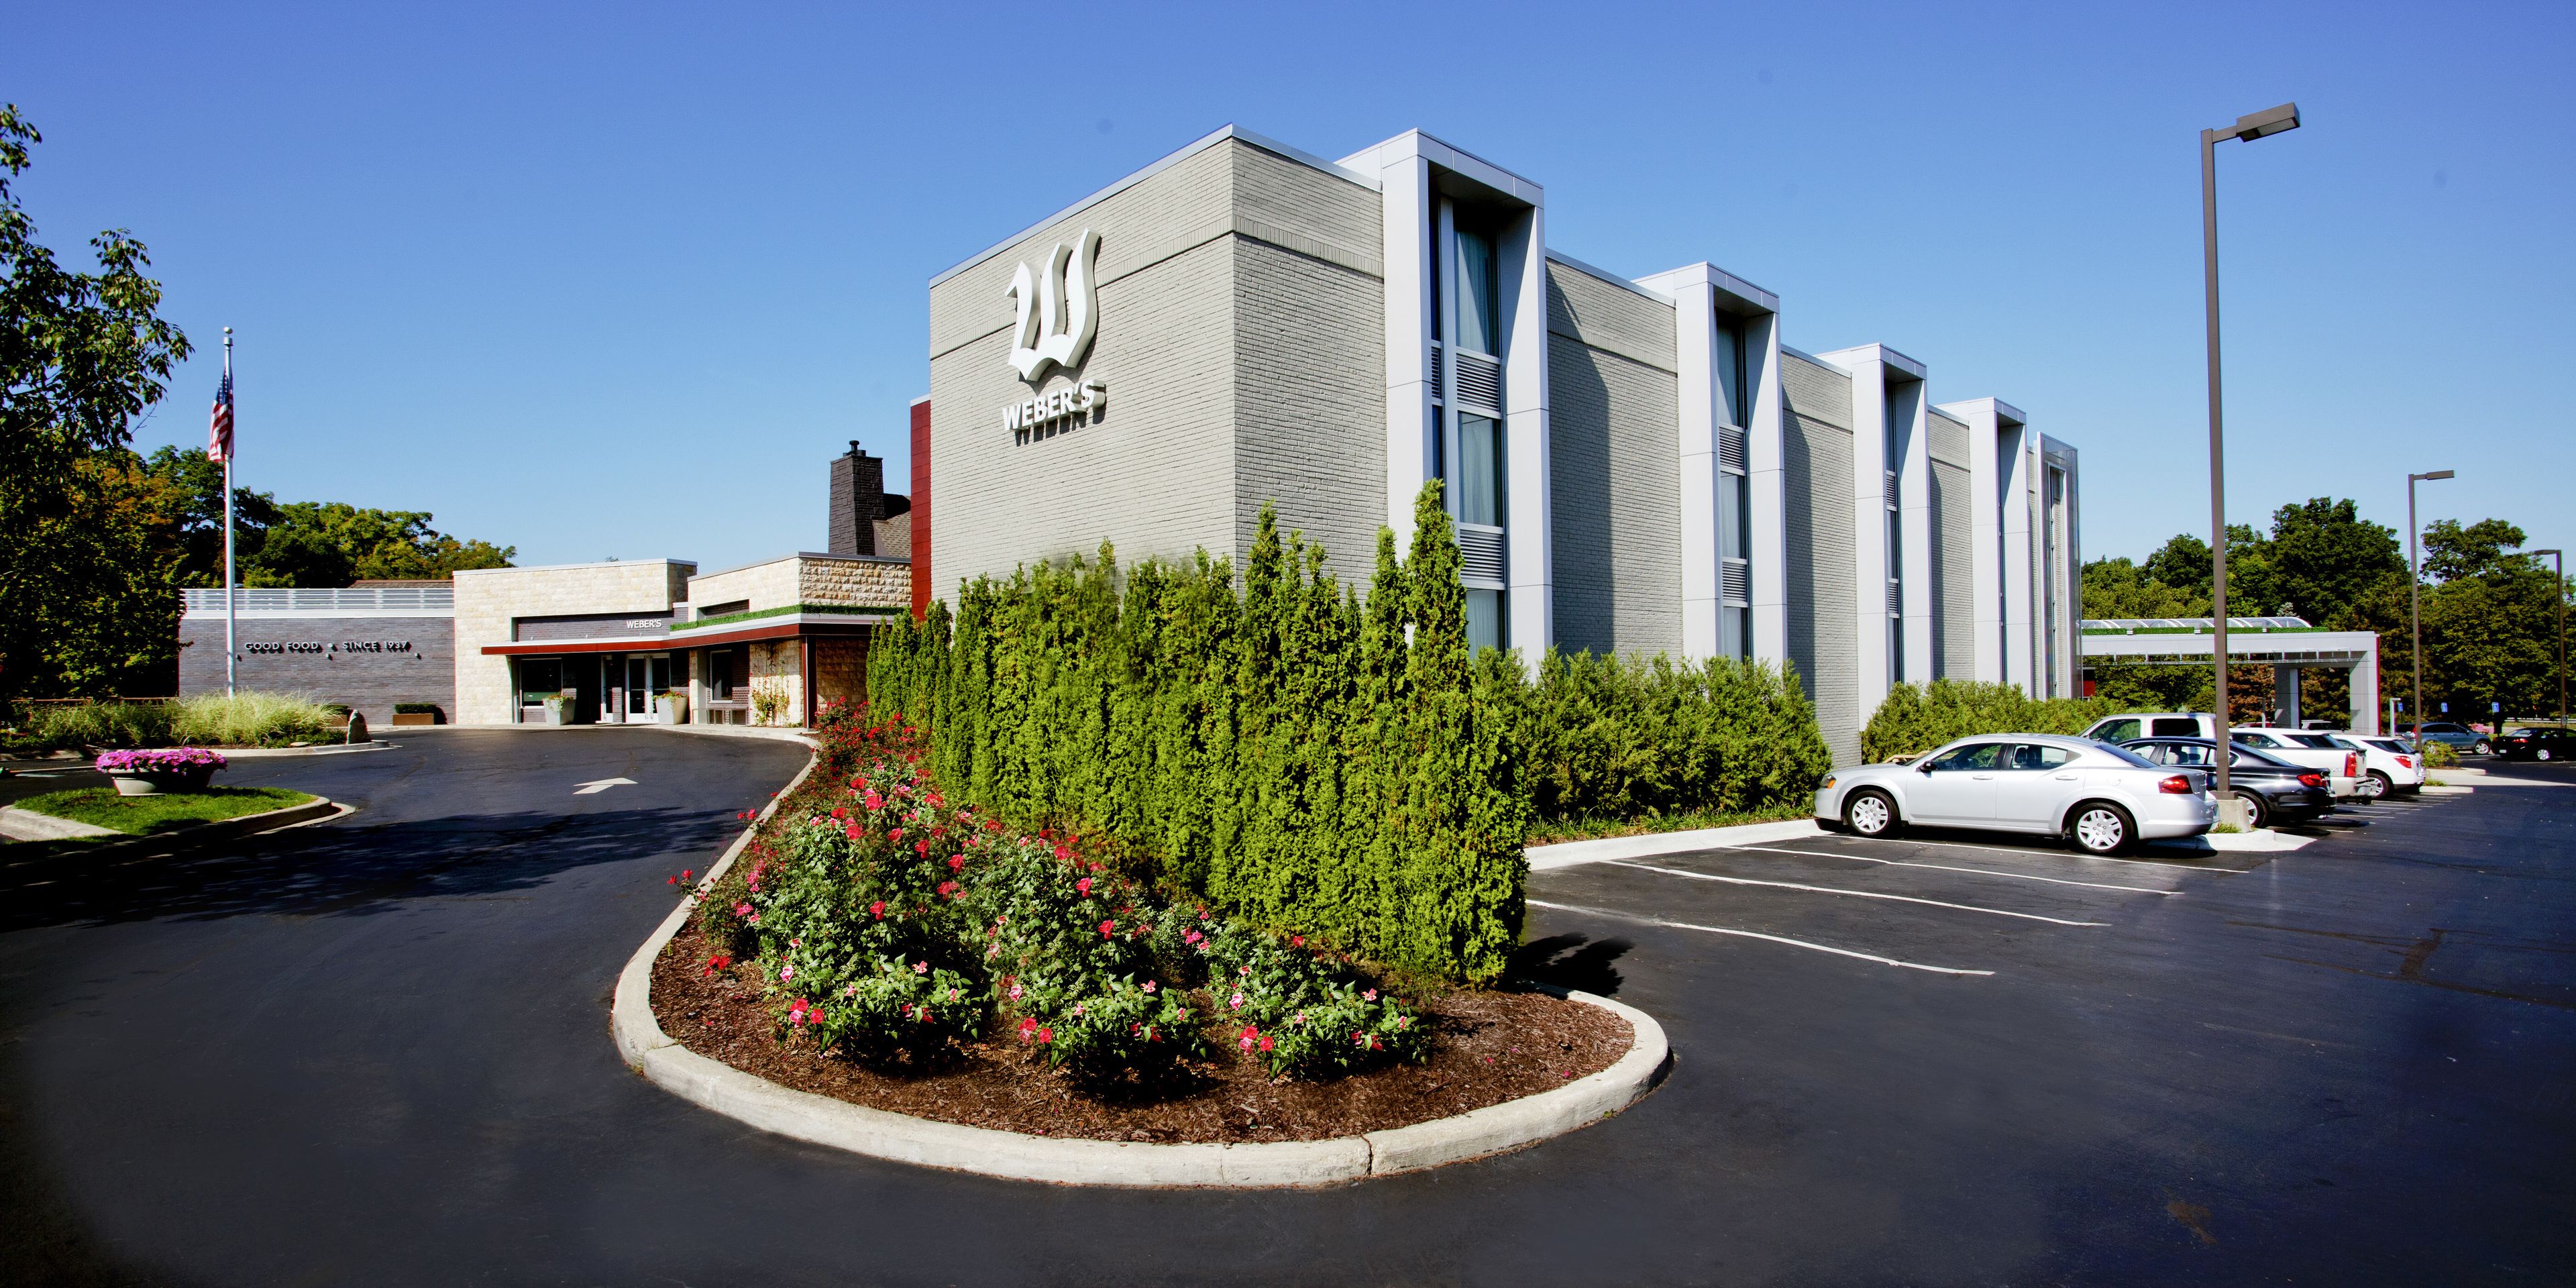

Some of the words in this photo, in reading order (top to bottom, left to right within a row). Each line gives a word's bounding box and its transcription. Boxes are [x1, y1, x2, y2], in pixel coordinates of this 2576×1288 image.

[1002, 379, 1106, 431] WEBER'S
[626, 619, 662, 629] WEBER'S
[244, 642, 280, 650] GOOD
[342, 641, 377, 649] SINCE
[384, 641, 407, 649] 1937
